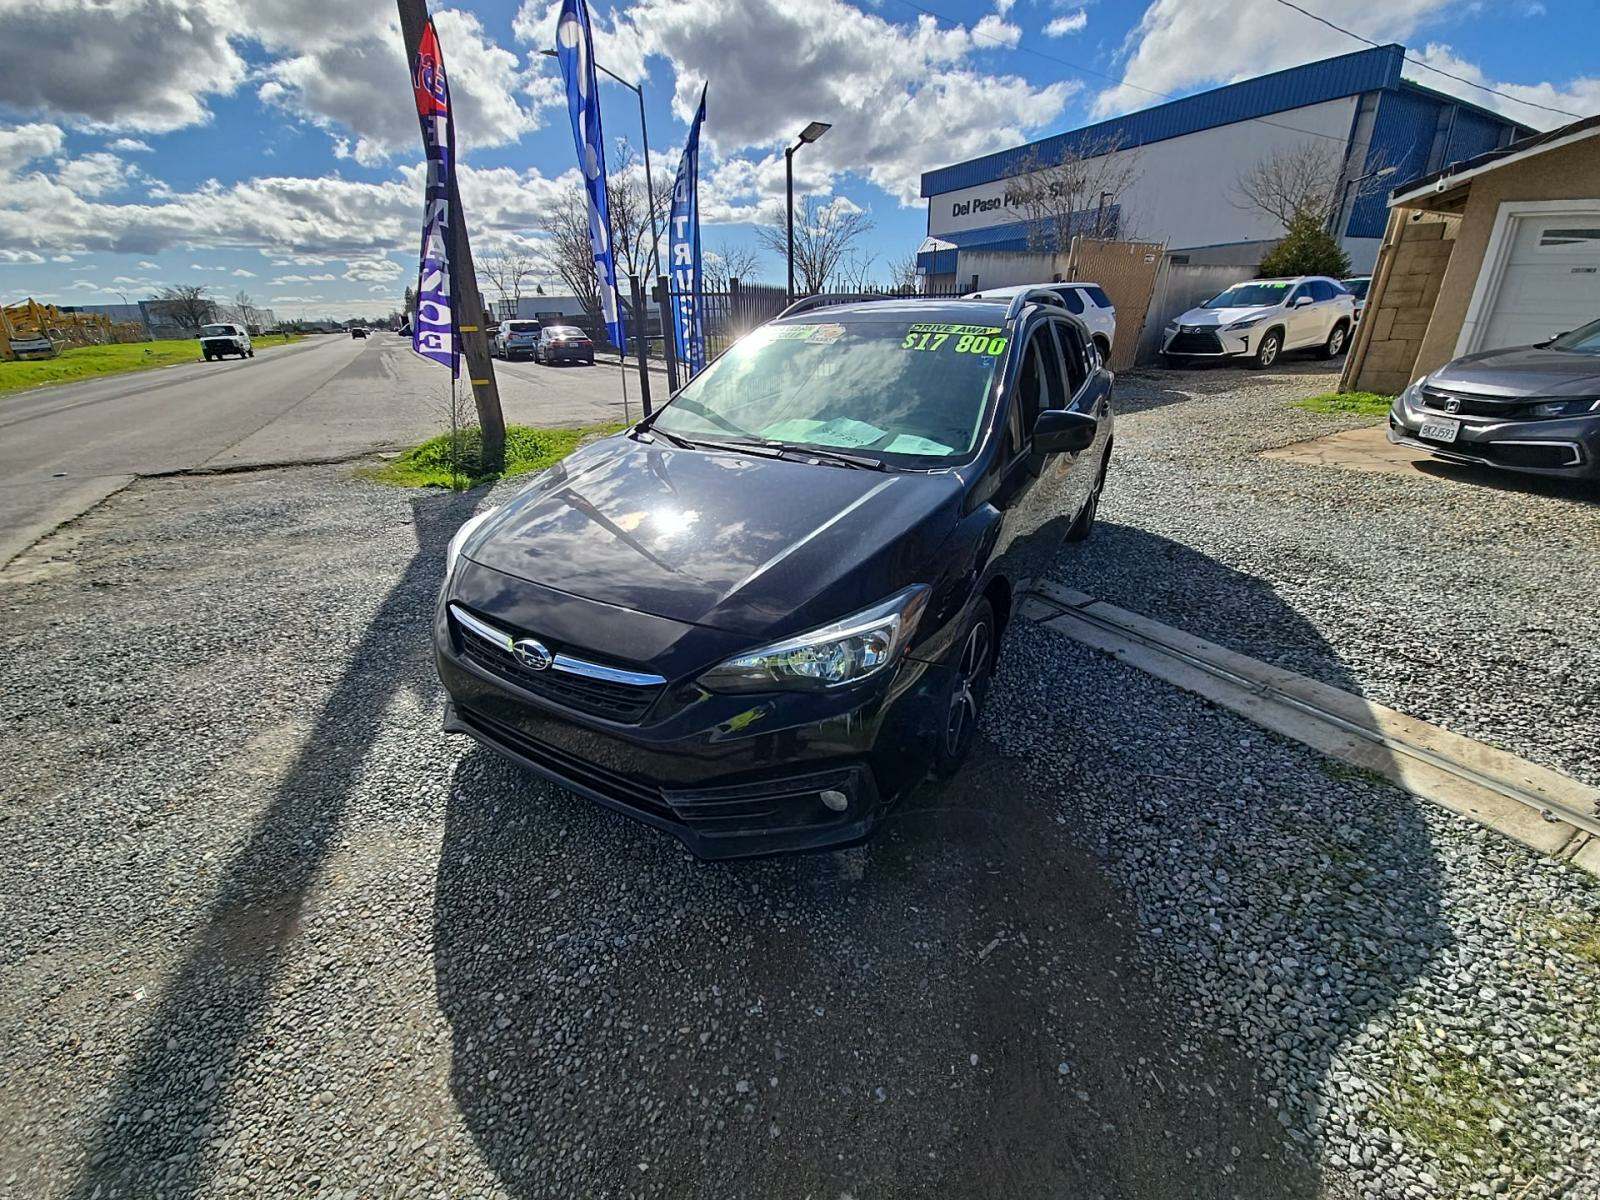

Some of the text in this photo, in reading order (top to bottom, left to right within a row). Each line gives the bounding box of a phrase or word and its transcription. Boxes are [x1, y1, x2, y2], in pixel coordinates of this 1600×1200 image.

[952, 200, 971, 217] Del
[972, 197, 1001, 213] Paso
[912, 324, 957, 333] DRIVE
[902, 332, 1008, 356] $17 800
